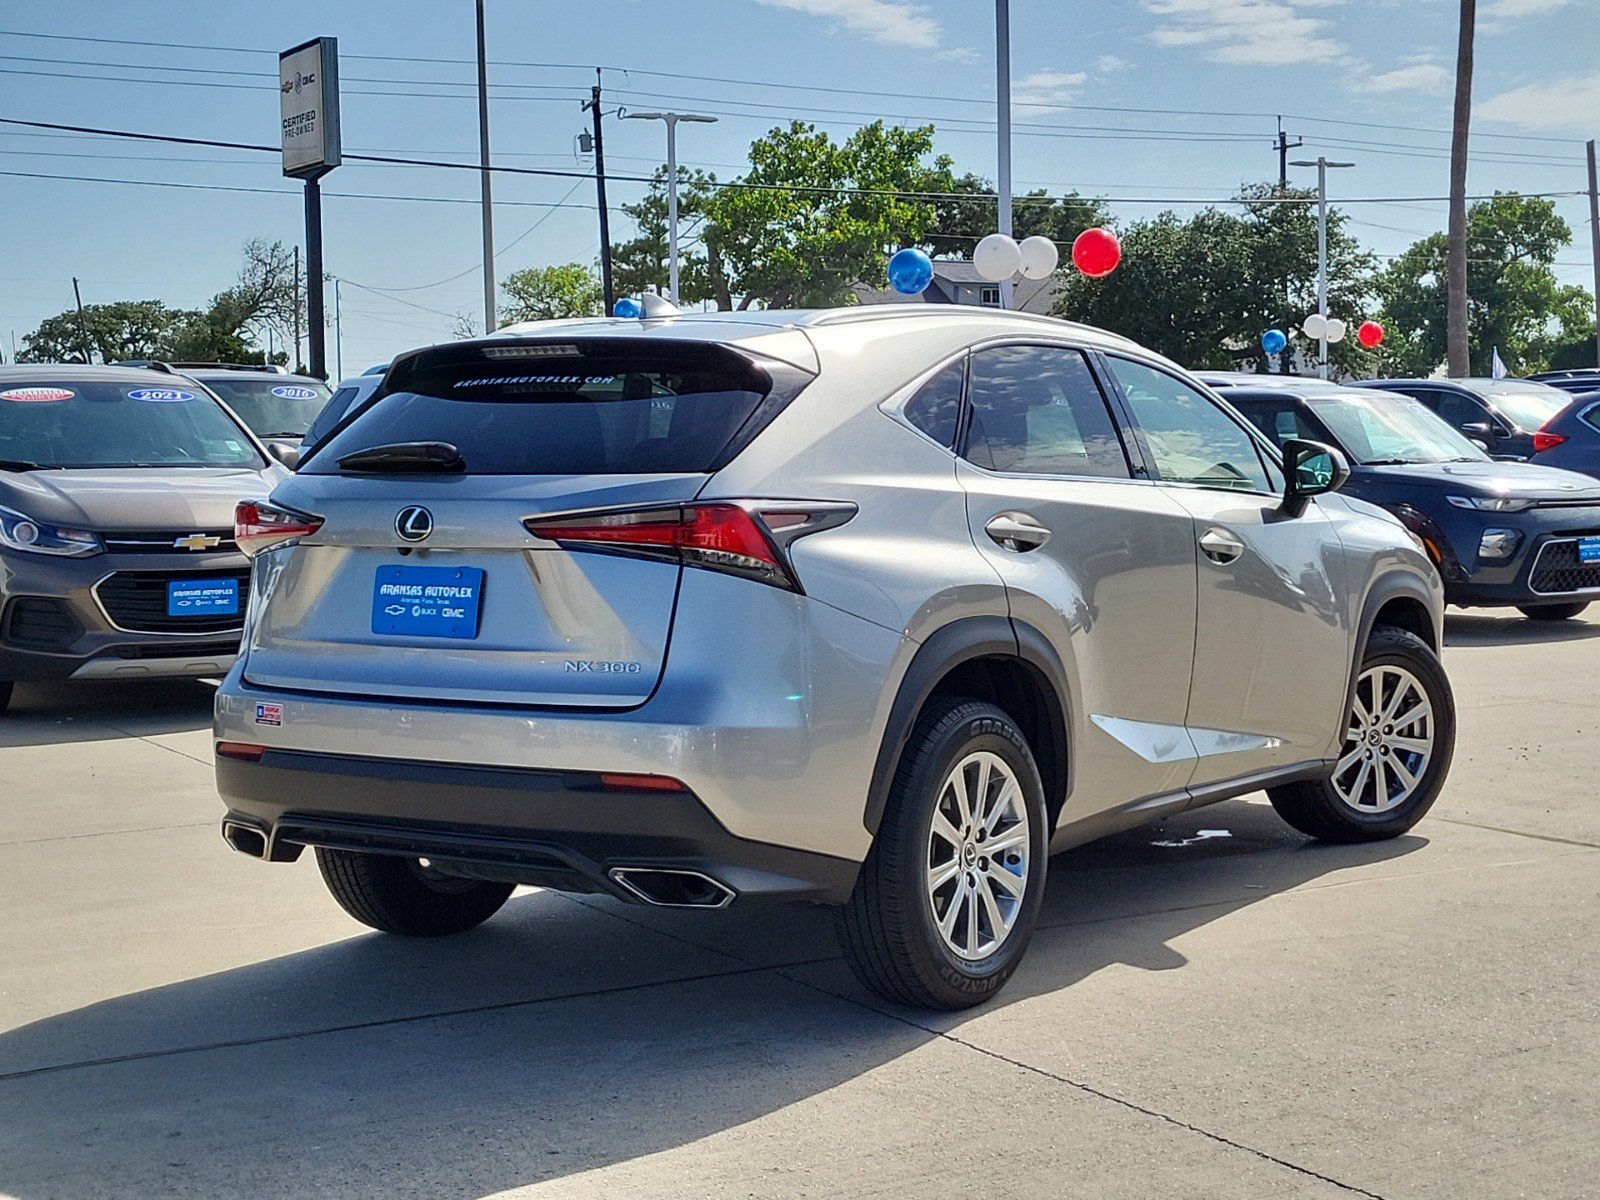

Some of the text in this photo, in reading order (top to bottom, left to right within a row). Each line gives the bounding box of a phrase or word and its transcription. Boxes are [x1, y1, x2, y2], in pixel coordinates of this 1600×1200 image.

[302, 74, 315, 86] GMC
[283, 110, 316, 129] CERTIFIED
[285, 121, 315, 138] PRE-OWNED
[453, 375, 615, 388] ARANSASAUTOPLEX.COM
[141, 390, 183, 400] 2021
[281, 388, 309, 398] 2016
[380, 584, 473, 598] ARANSAS AUTOPLEX
[441, 607, 465, 618] GMC
[940, 966, 998, 993] DUNLOP
